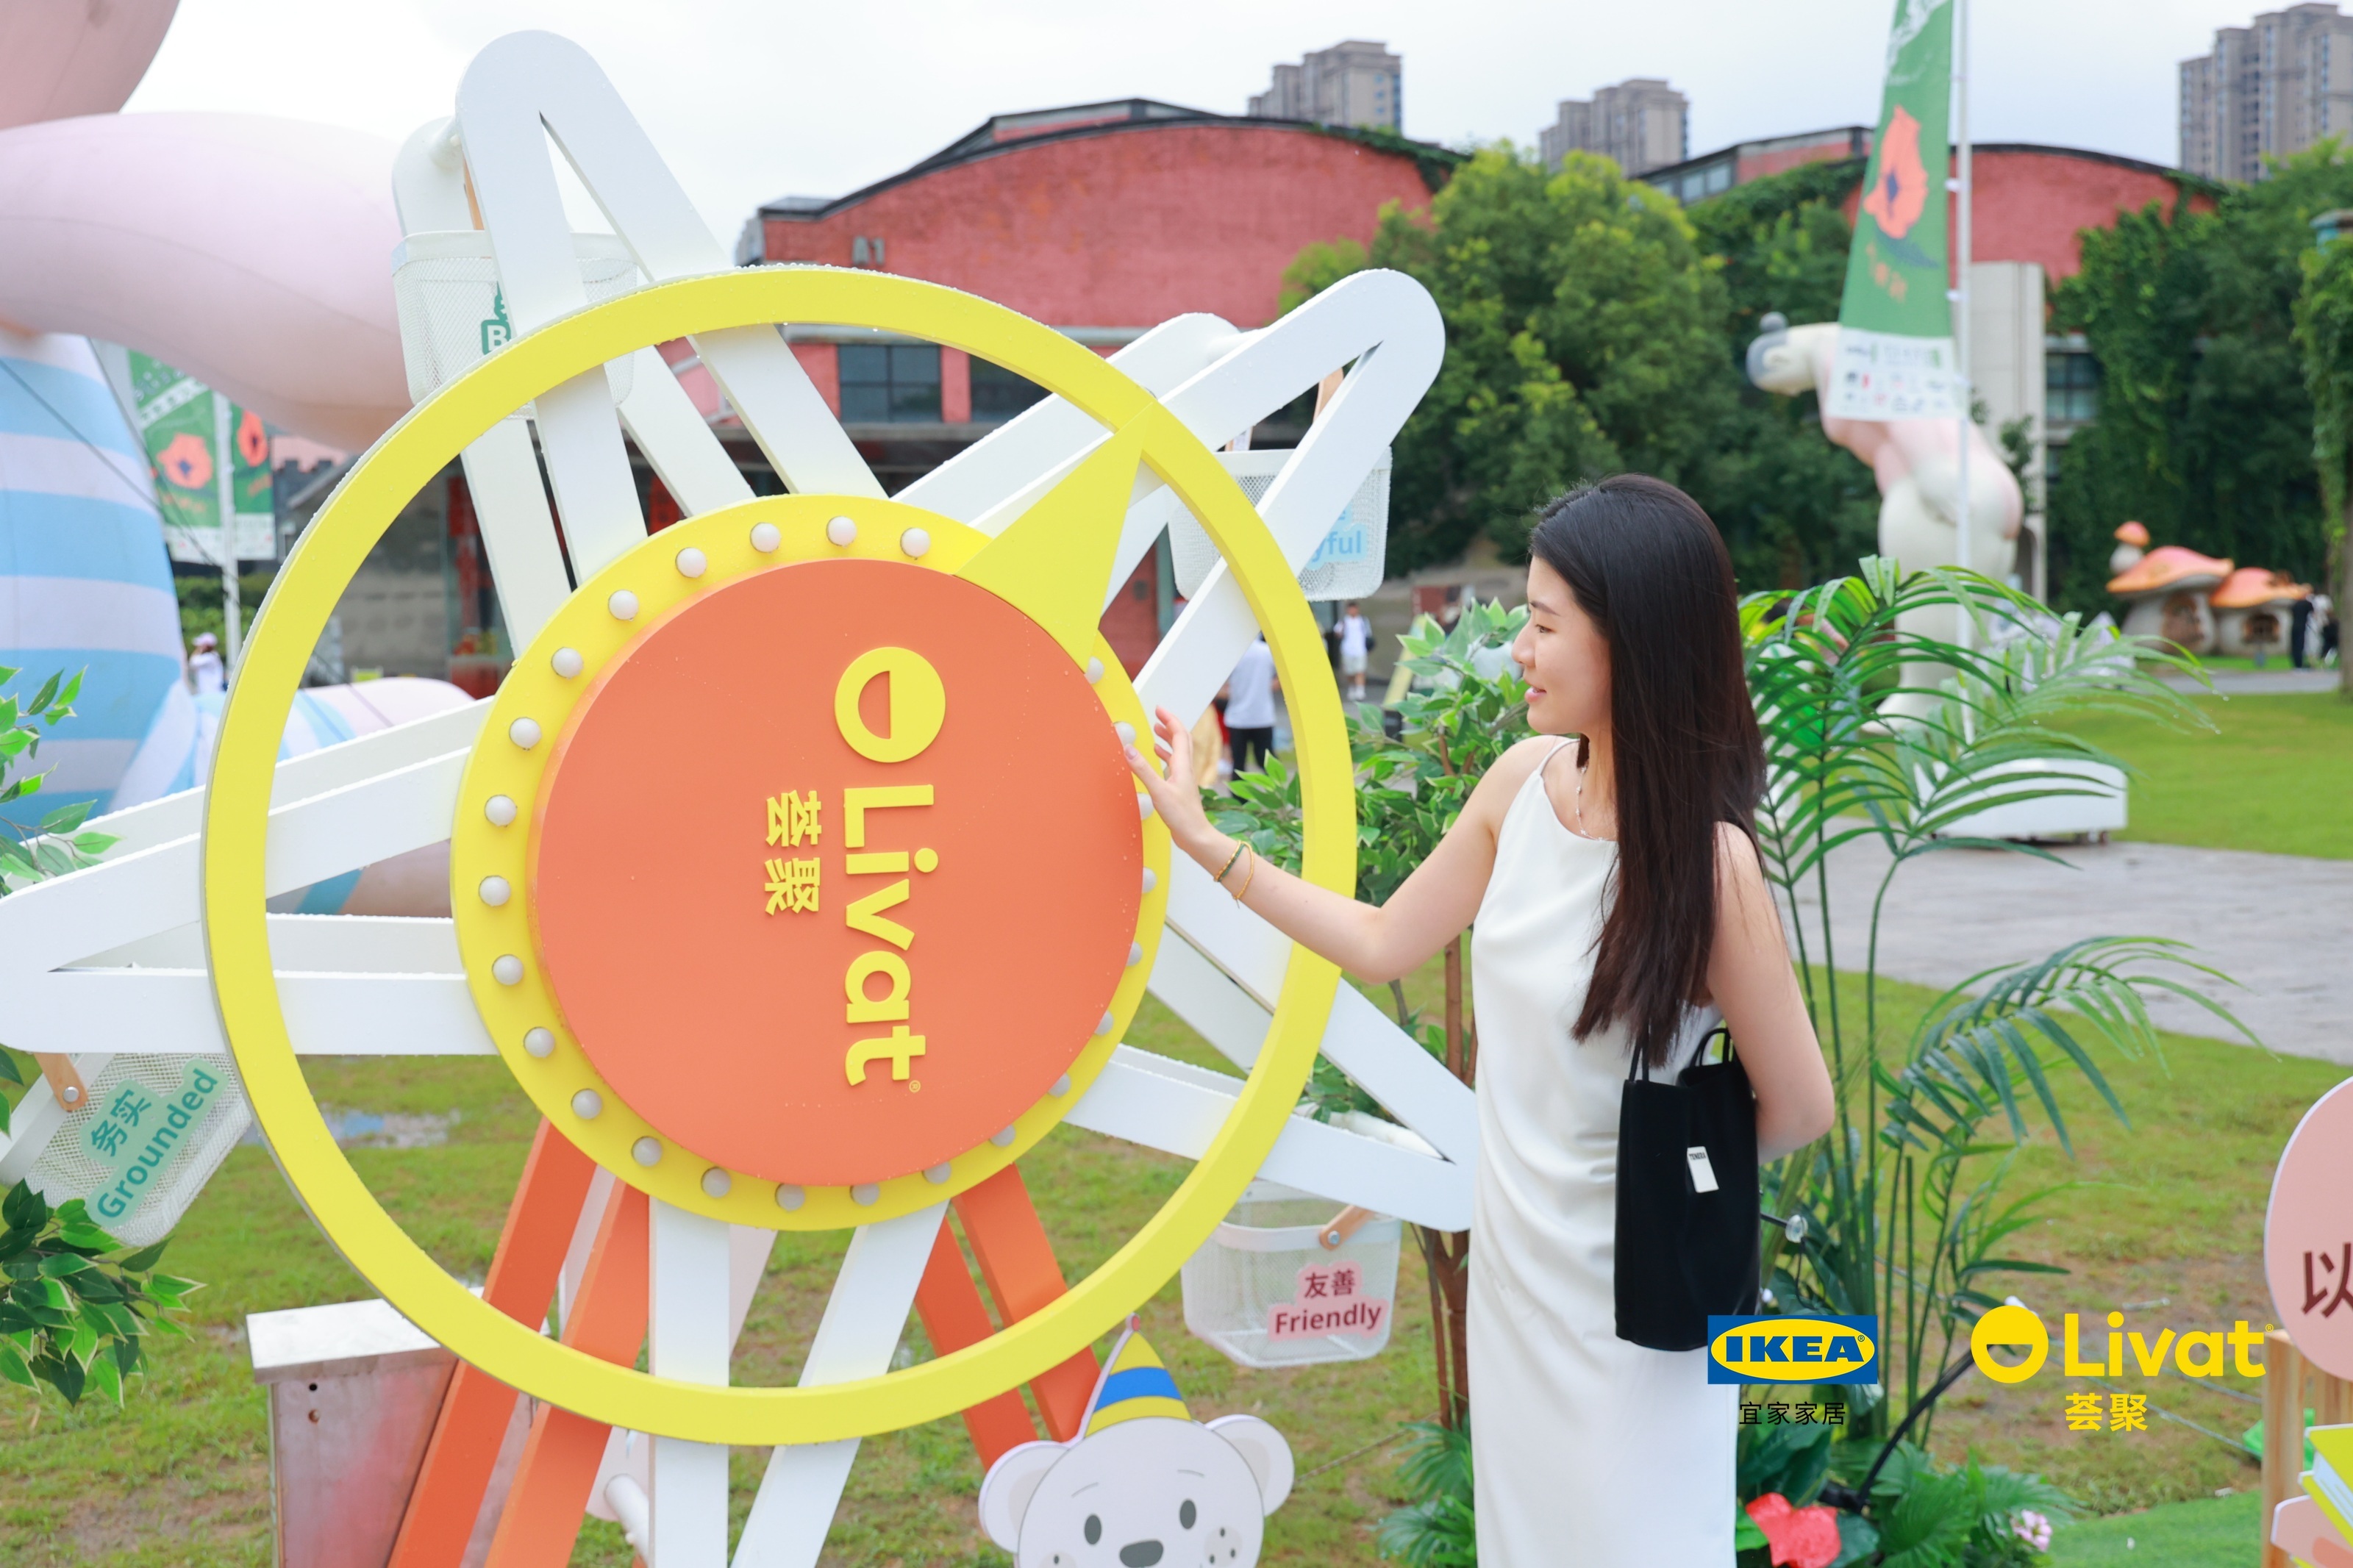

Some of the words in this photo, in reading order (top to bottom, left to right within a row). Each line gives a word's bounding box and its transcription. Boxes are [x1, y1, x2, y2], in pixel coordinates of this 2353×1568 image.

[852, 236, 885, 265] A1
[1311, 530, 1362, 562] yful
[765, 790, 822, 916] 荟聚
[90, 1089, 151, 1157] 务实
[96, 1067, 219, 1219] Grounded
[1304, 1267, 1355, 1299] 友善
[2302, 1242, 2353, 1319] 以
[1275, 1303, 1382, 1334] Friendly
